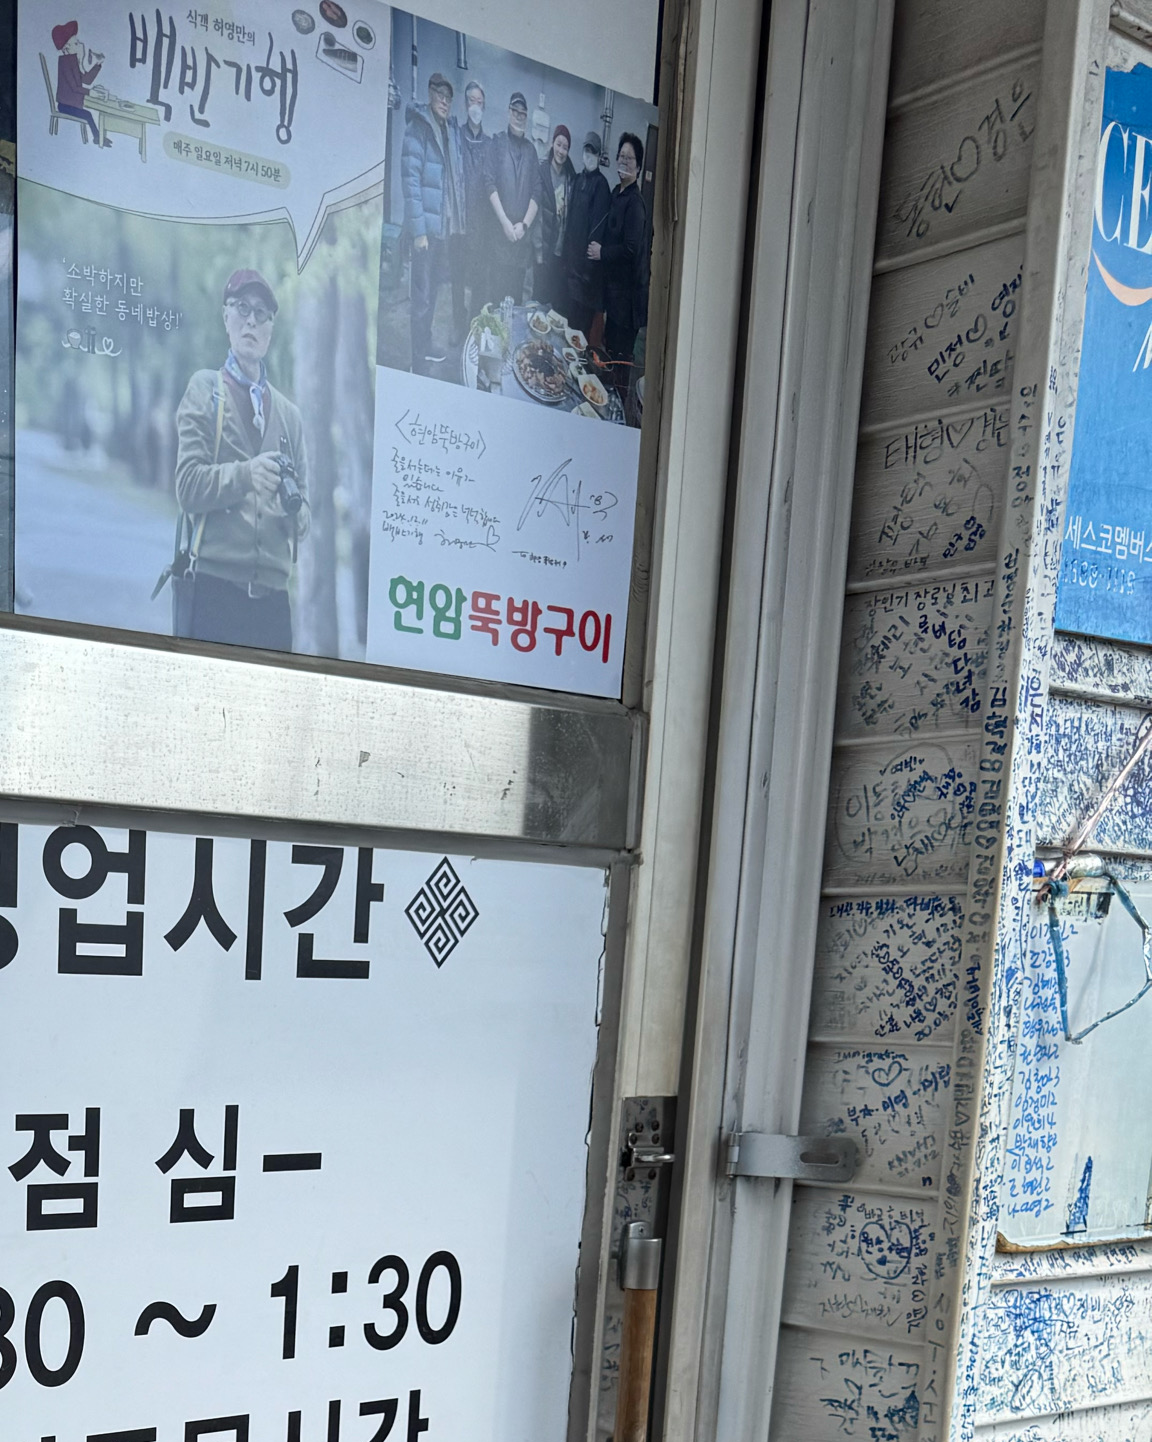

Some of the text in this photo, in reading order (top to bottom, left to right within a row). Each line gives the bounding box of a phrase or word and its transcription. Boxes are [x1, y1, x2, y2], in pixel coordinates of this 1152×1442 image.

[186, 9, 255, 46] 식객 허영만의
[129, 8, 298, 145] 백반기행
[173, 139, 282, 182] 매주 일요일 저녁 7시 50분
[62, 287, 109, 315] 확실한
[270, 1250, 462, 1359] 1:30
